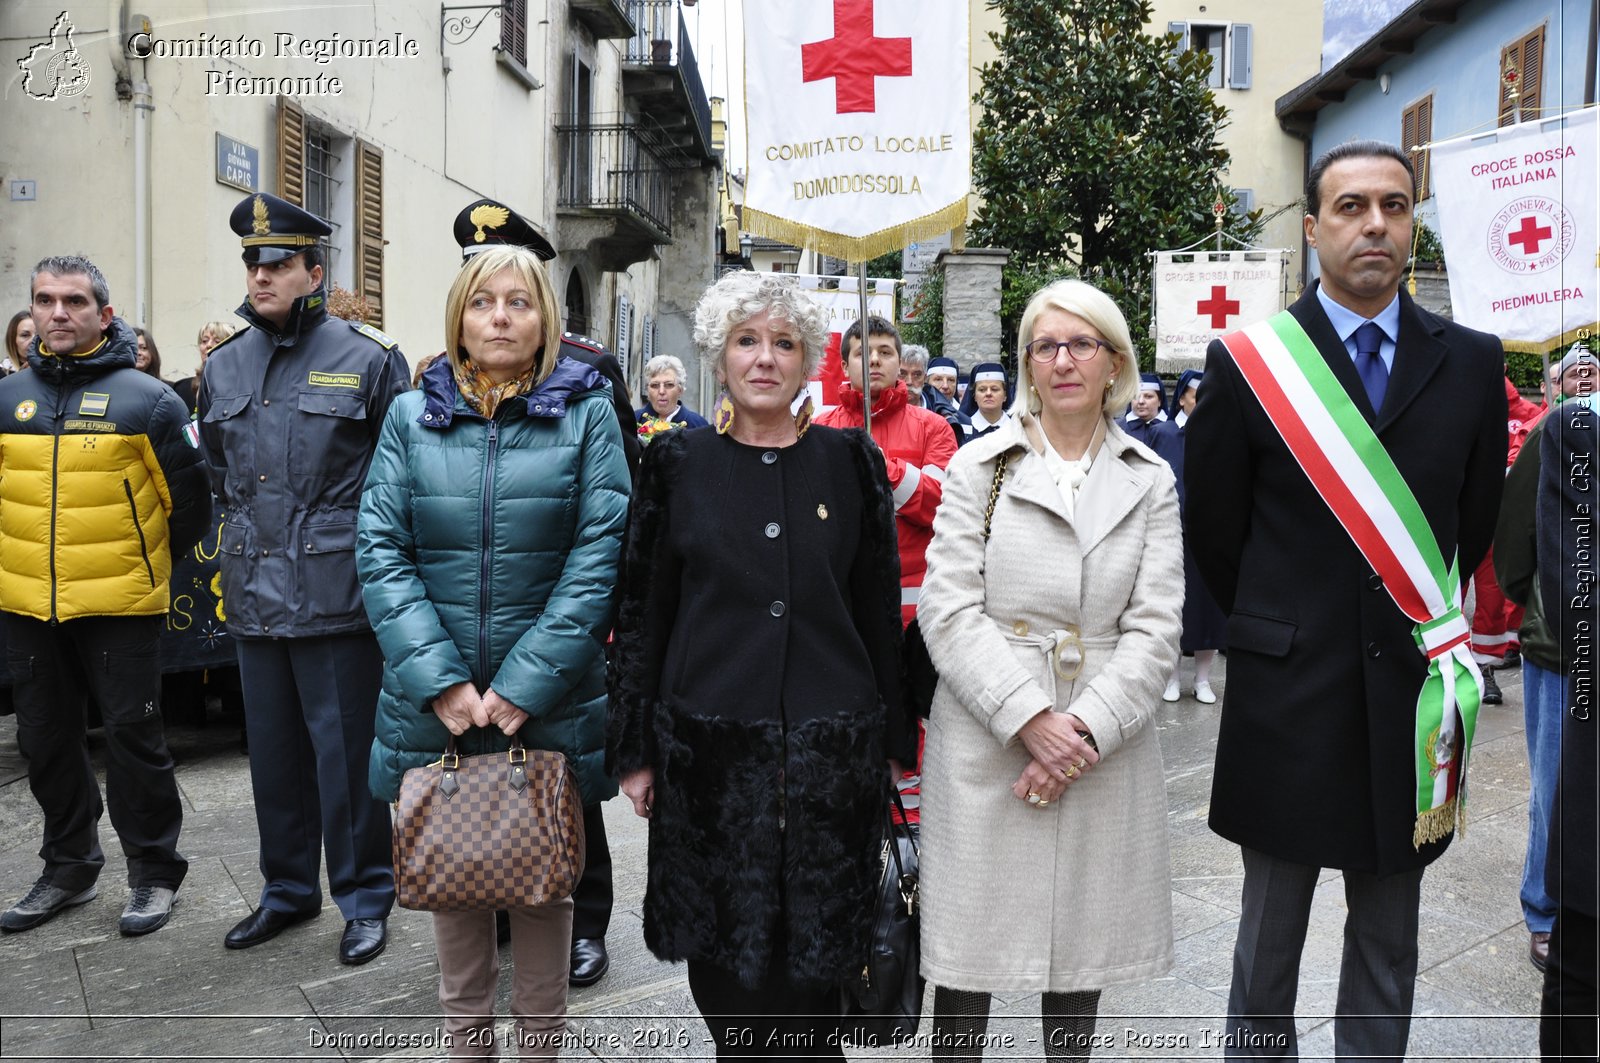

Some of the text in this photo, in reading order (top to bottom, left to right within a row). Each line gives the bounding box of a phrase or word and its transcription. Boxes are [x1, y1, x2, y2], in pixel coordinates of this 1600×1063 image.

[232, 141, 246, 158] VIA
[765, 134, 953, 161] COMITATO LOCALE
[227, 152, 251, 170] GIOVANNI
[1471, 145, 1576, 177] CROCE ROSSA
[226, 165, 252, 187] CAPIS
[1492, 167, 1557, 190] ITALIANA
[20, 186, 27, 196] 4
[793, 174, 923, 200] DOMODOSSOLA
[1499, 211, 1512, 223] DI
[1509, 199, 1554, 216] GINEVRA
[1490, 222, 1527, 271] CONVENZIONE
[1165, 269, 1273, 282] CROCE ROSSA ITALIANA
[1492, 287, 1584, 313] PIEDIMULERA
[311, 374, 332, 383] GUARDIA
[337, 377, 358, 385] FINANZA
